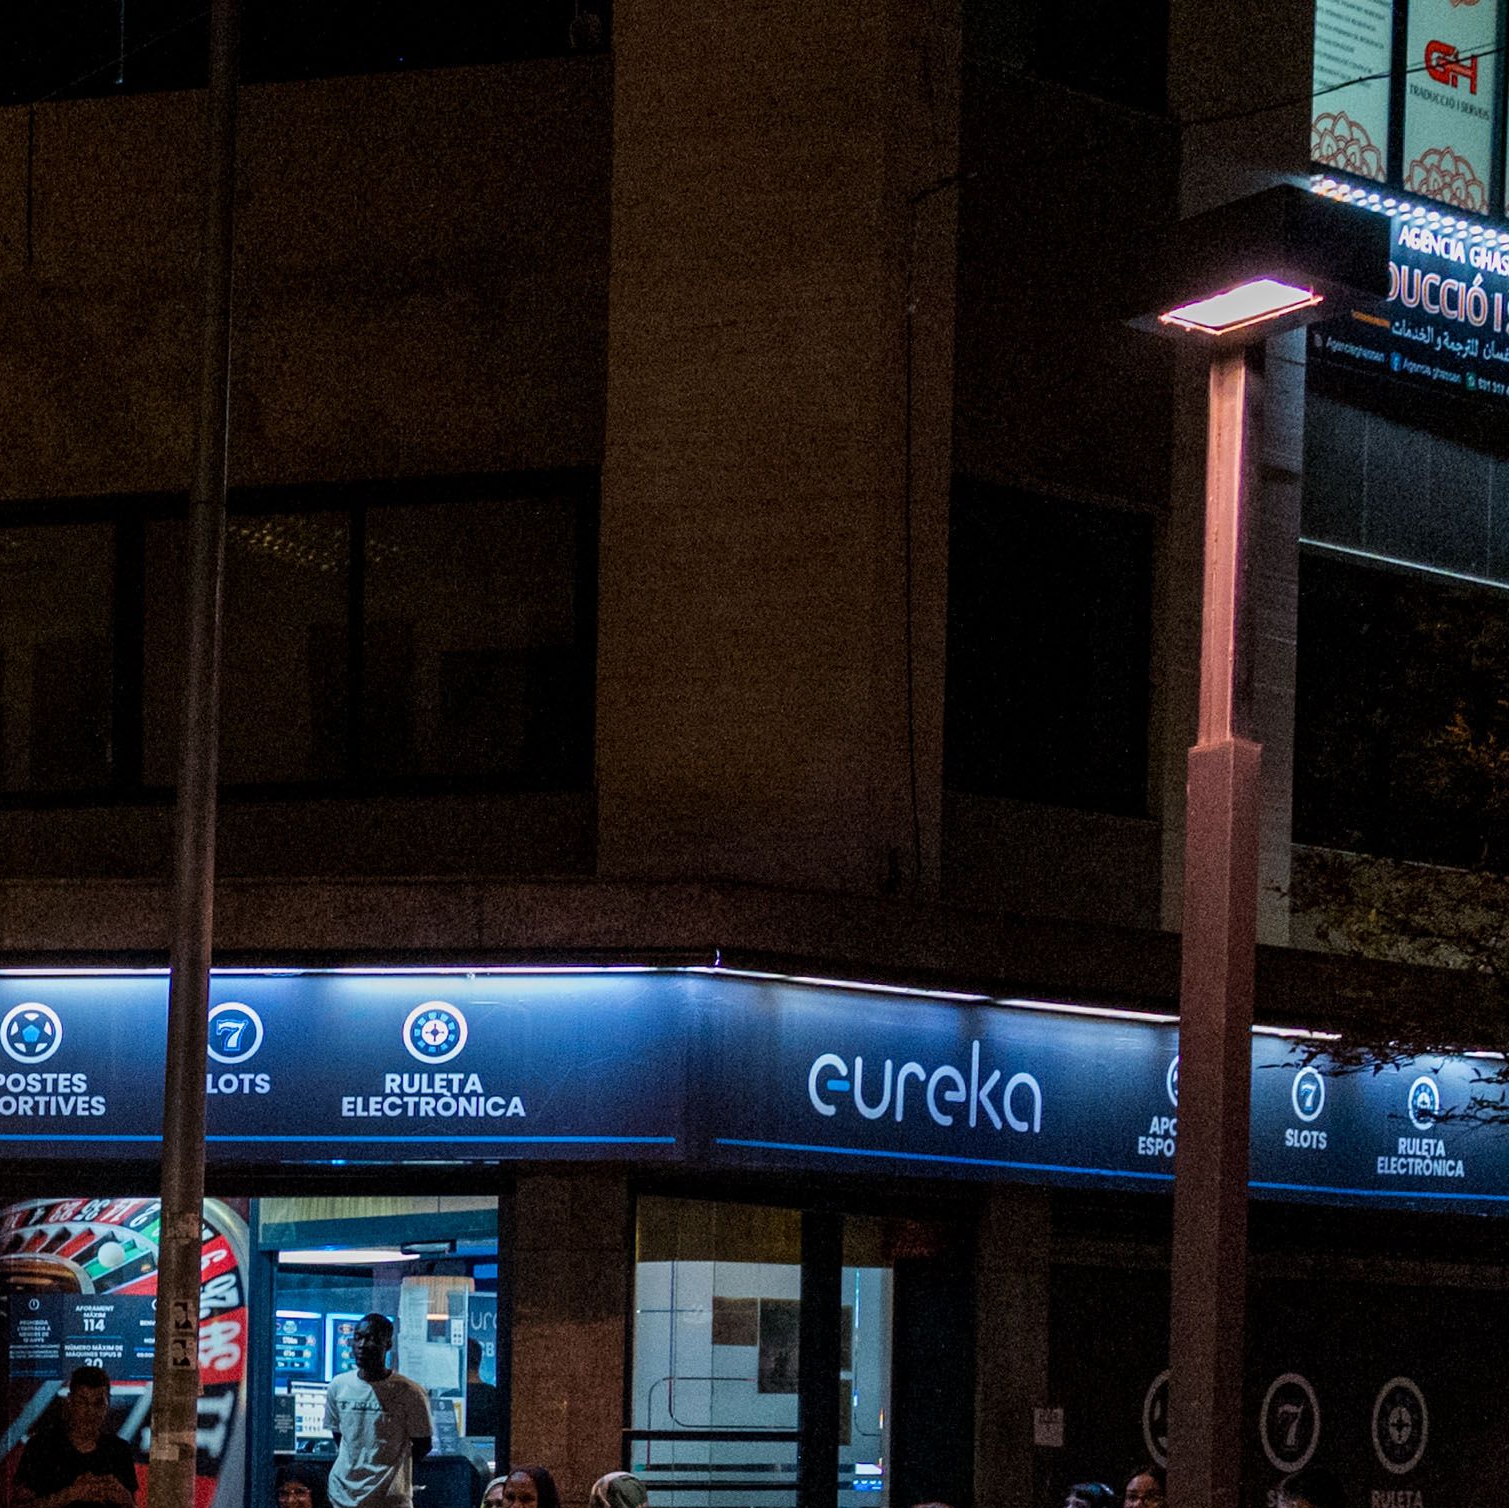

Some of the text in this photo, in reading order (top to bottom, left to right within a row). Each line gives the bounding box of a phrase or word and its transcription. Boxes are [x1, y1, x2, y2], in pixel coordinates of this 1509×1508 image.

[1461, 99, 1491, 121] SERVEIS
[1398, 225, 1465, 264] AGENCIA
[206, 1073, 271, 1094] LOTS
[384, 1072, 483, 1094] RULETA
[807, 1039, 1042, 1134] eureka
[341, 1090, 527, 1118] ELECTRÒNICA
[1284, 1127, 1328, 1151] SLOTS
[1397, 1137, 1446, 1159] RULETA
[1376, 1151, 1465, 1179] ELECTRÒNICA
[83, 1319, 105, 1332] 114
